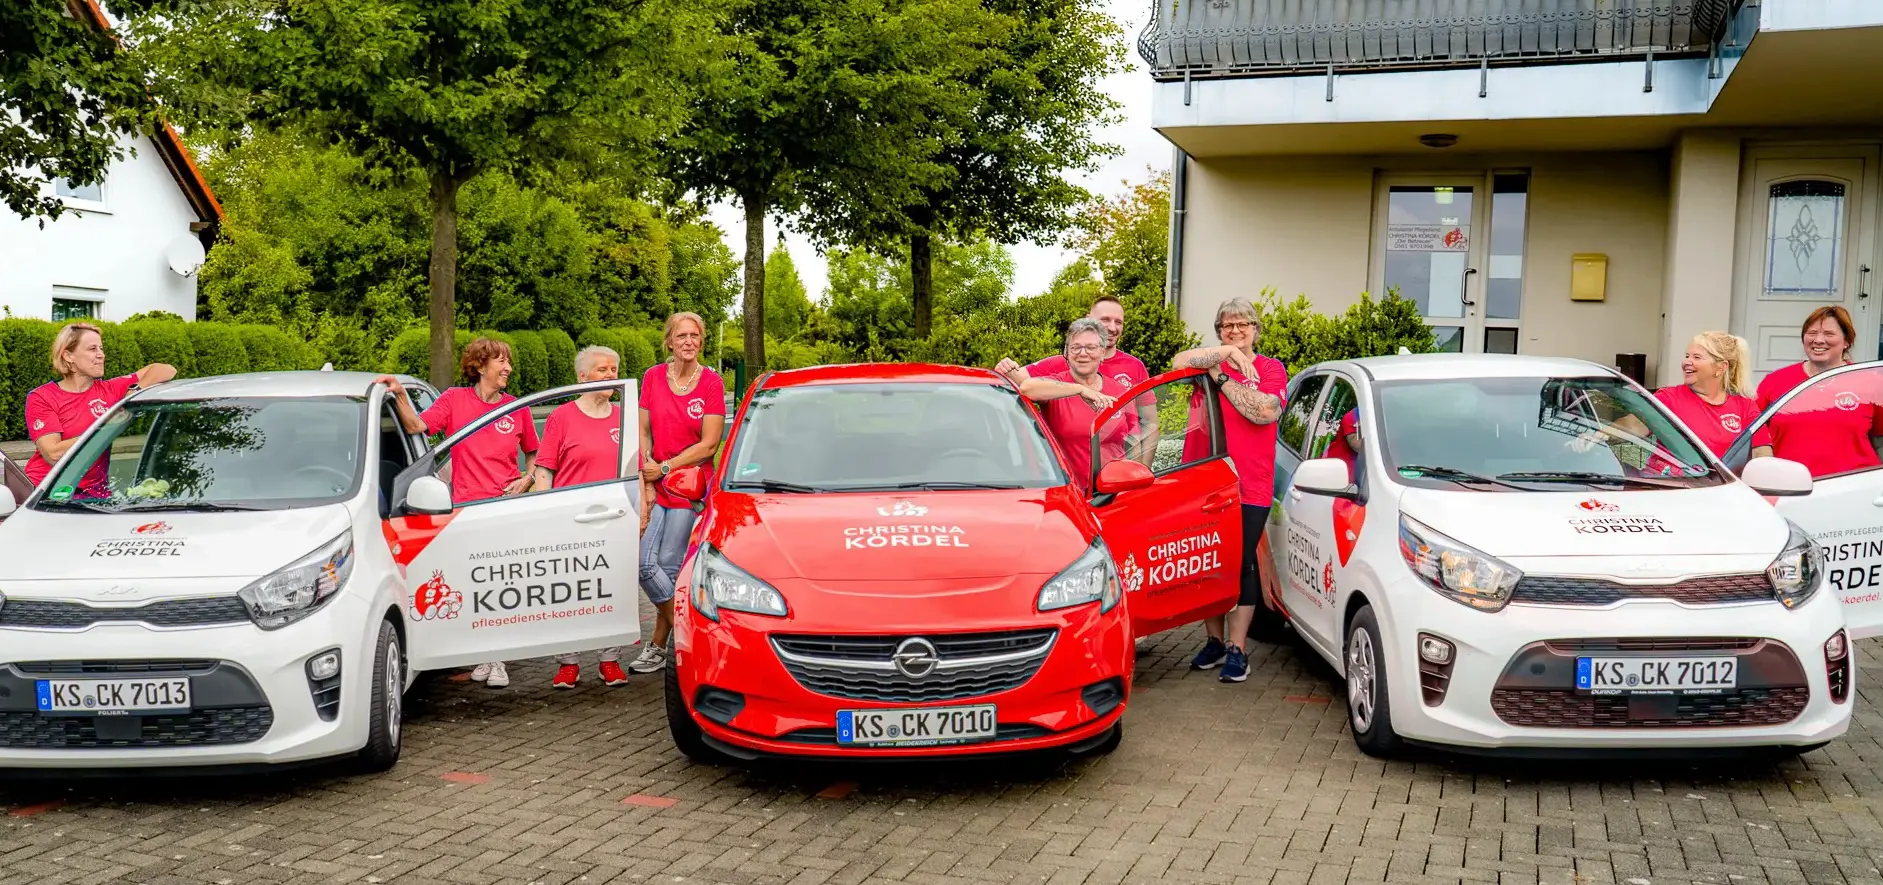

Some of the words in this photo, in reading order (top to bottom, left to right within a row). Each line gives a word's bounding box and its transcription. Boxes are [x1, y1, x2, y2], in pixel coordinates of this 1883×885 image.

[844, 525, 966, 536] CHRISTINA
[845, 533, 970, 550] KÖRDEL
[468, 546, 536, 561] AMBULANTER
[539, 540, 607, 554] PFLEGEDIENST
[1148, 531, 1222, 562] CHRISTINA
[1287, 528, 1320, 564] CHRISTINA
[470, 553, 610, 584] CHRISTINA
[1149, 550, 1222, 586] KÖRDEL
[472, 577, 613, 614] KÖRDEL
[471, 603, 614, 630] pflegedienst-koerdel.de
[1594, 661, 1625, 685] KS
[1641, 661, 1671, 685] CK
[1677, 661, 1734, 685] 7012
[53, 683, 81, 707] KS
[96, 683, 125, 707] CK
[130, 681, 186, 705] 7013
[854, 714, 884, 739] KS
[901, 713, 931, 737] CK
[936, 709, 992, 735] 7010
